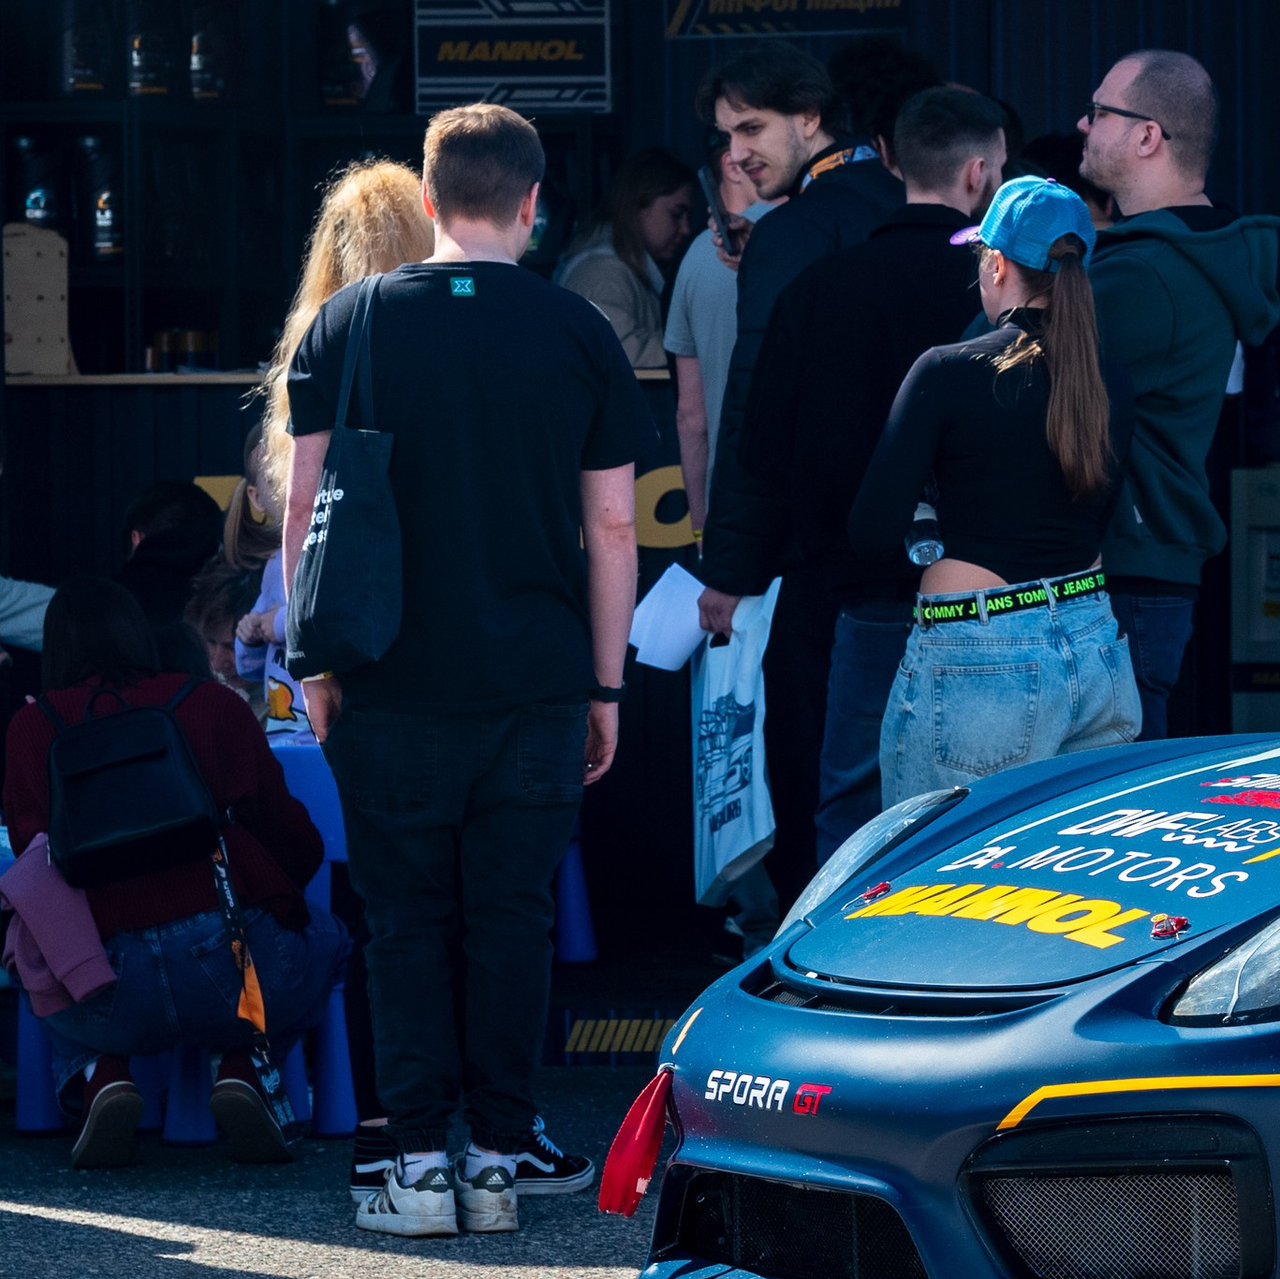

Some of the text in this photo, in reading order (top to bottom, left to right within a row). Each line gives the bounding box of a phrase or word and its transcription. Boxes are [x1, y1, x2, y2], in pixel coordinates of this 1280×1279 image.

[437, 39, 586, 62] MANNOL
[922, 604, 964, 620] OMMY
[968, 595, 1014, 615] JANS
[1063, 576, 1096, 596] JEANS
[1006, 845, 1249, 899] MOTORS
[844, 883, 1152, 950] MANNOL
[704, 1069, 833, 1116] SPORA GT
